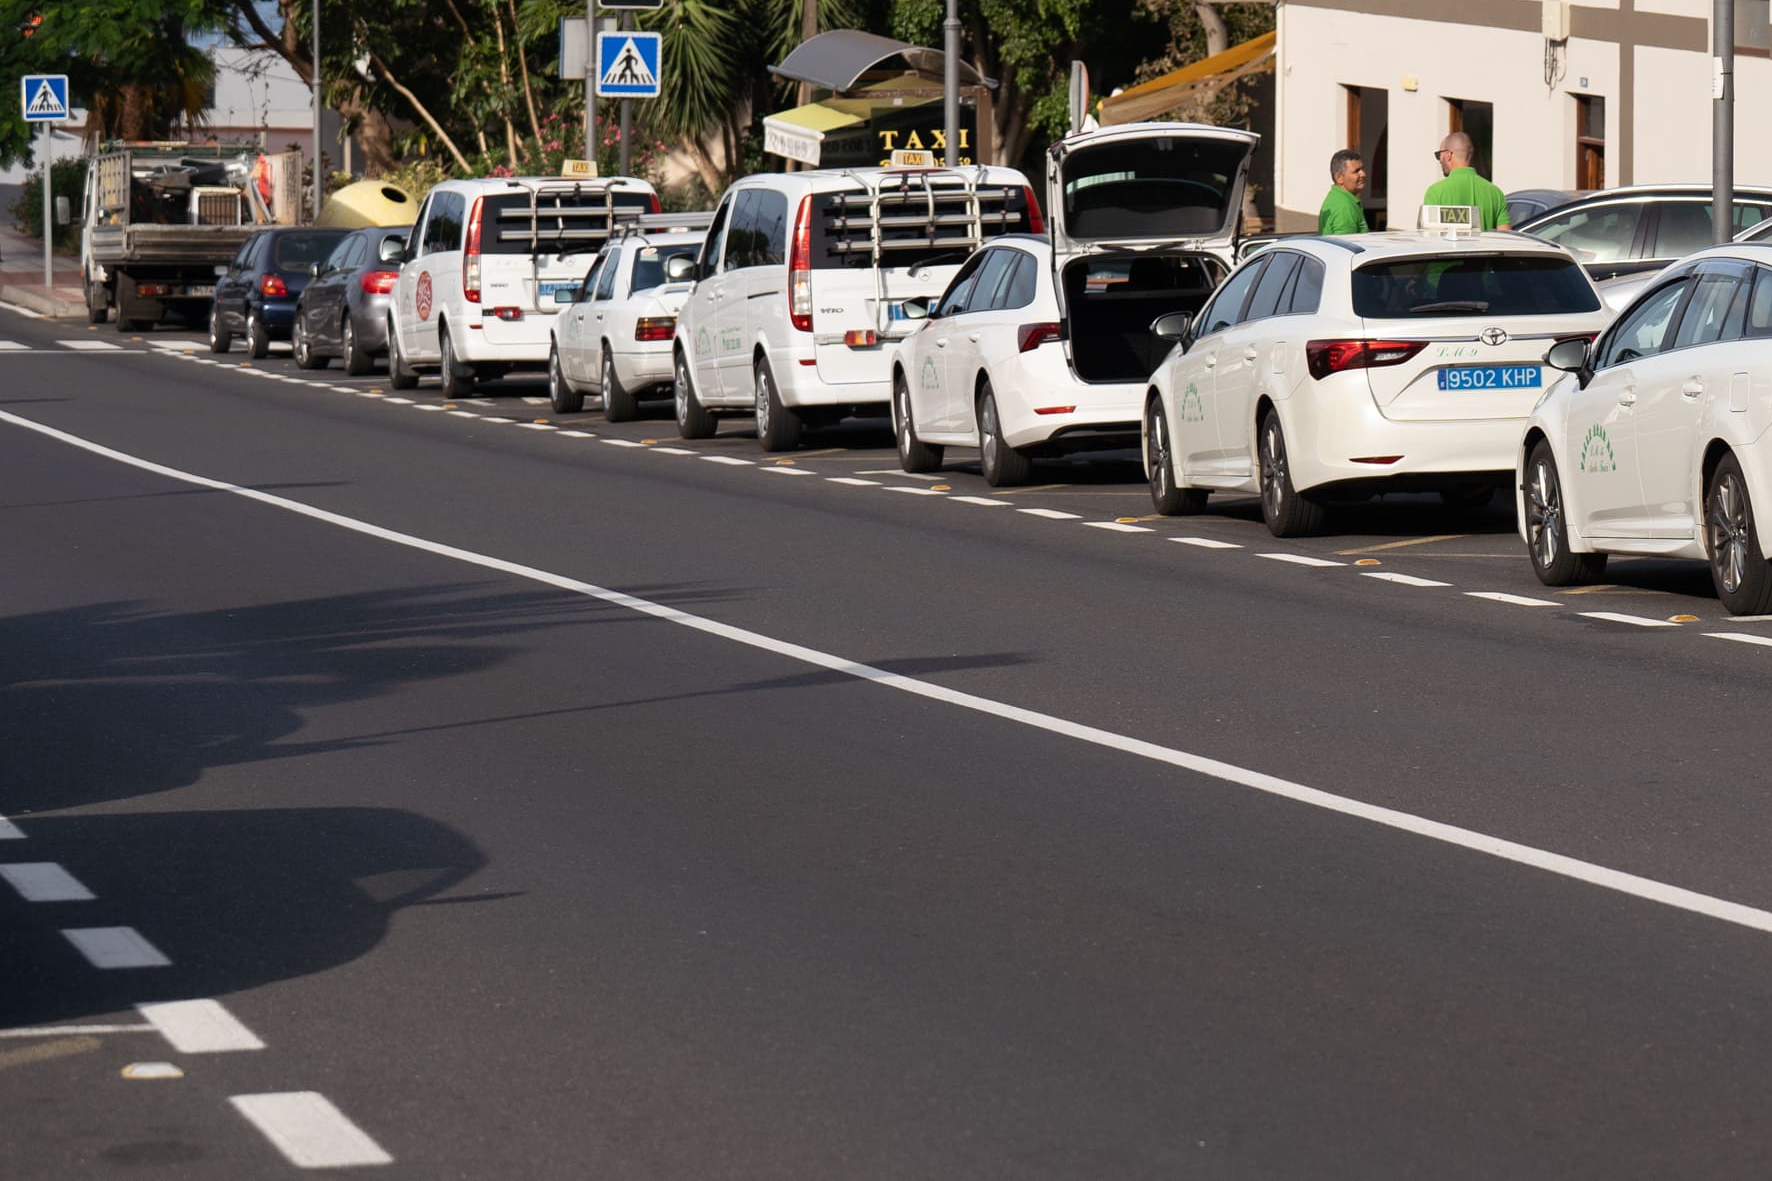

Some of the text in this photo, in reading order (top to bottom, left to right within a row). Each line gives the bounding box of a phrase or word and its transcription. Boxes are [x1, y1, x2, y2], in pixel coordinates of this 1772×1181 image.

[879, 129, 969, 150] TAXI
[902, 152, 925, 165] TAXI
[1440, 208, 1470, 223] TAXI
[1449, 368, 1537, 388] 9502 KHP
